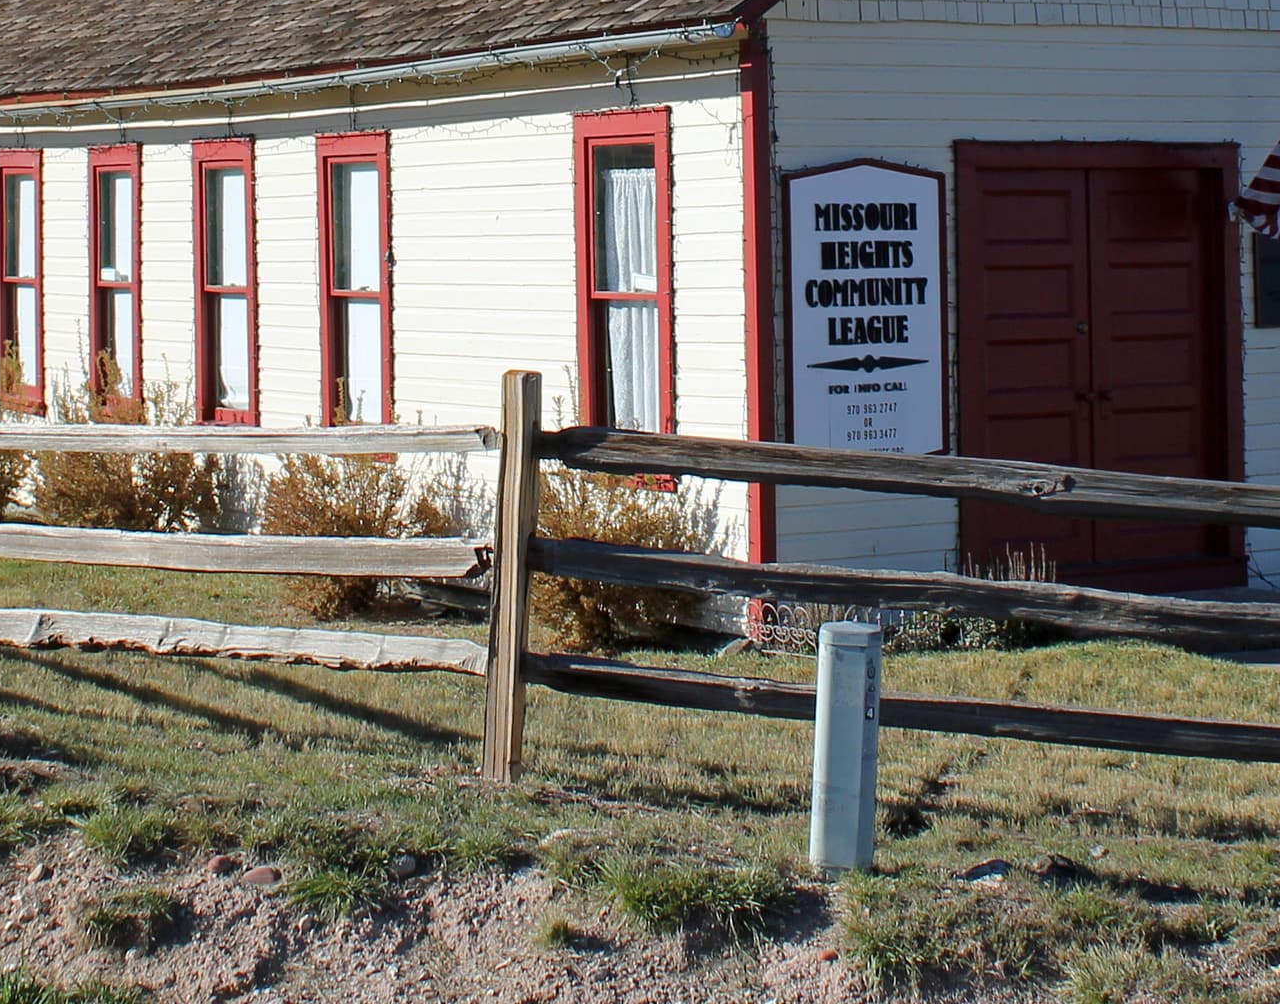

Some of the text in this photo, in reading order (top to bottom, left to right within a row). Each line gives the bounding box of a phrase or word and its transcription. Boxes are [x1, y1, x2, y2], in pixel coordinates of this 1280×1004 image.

[814, 203, 917, 231] MISSOURI
[821, 241, 913, 269] HEIGHTS
[805, 277, 928, 308] COMMUNITY
[828, 315, 909, 345] LEAGUE
[828, 382, 908, 394] FOR INFO CALL
[847, 404, 860, 415] 970
[879, 402, 897, 413] 2747
[864, 417, 873, 427] OR
[847, 431, 861, 441] 970
